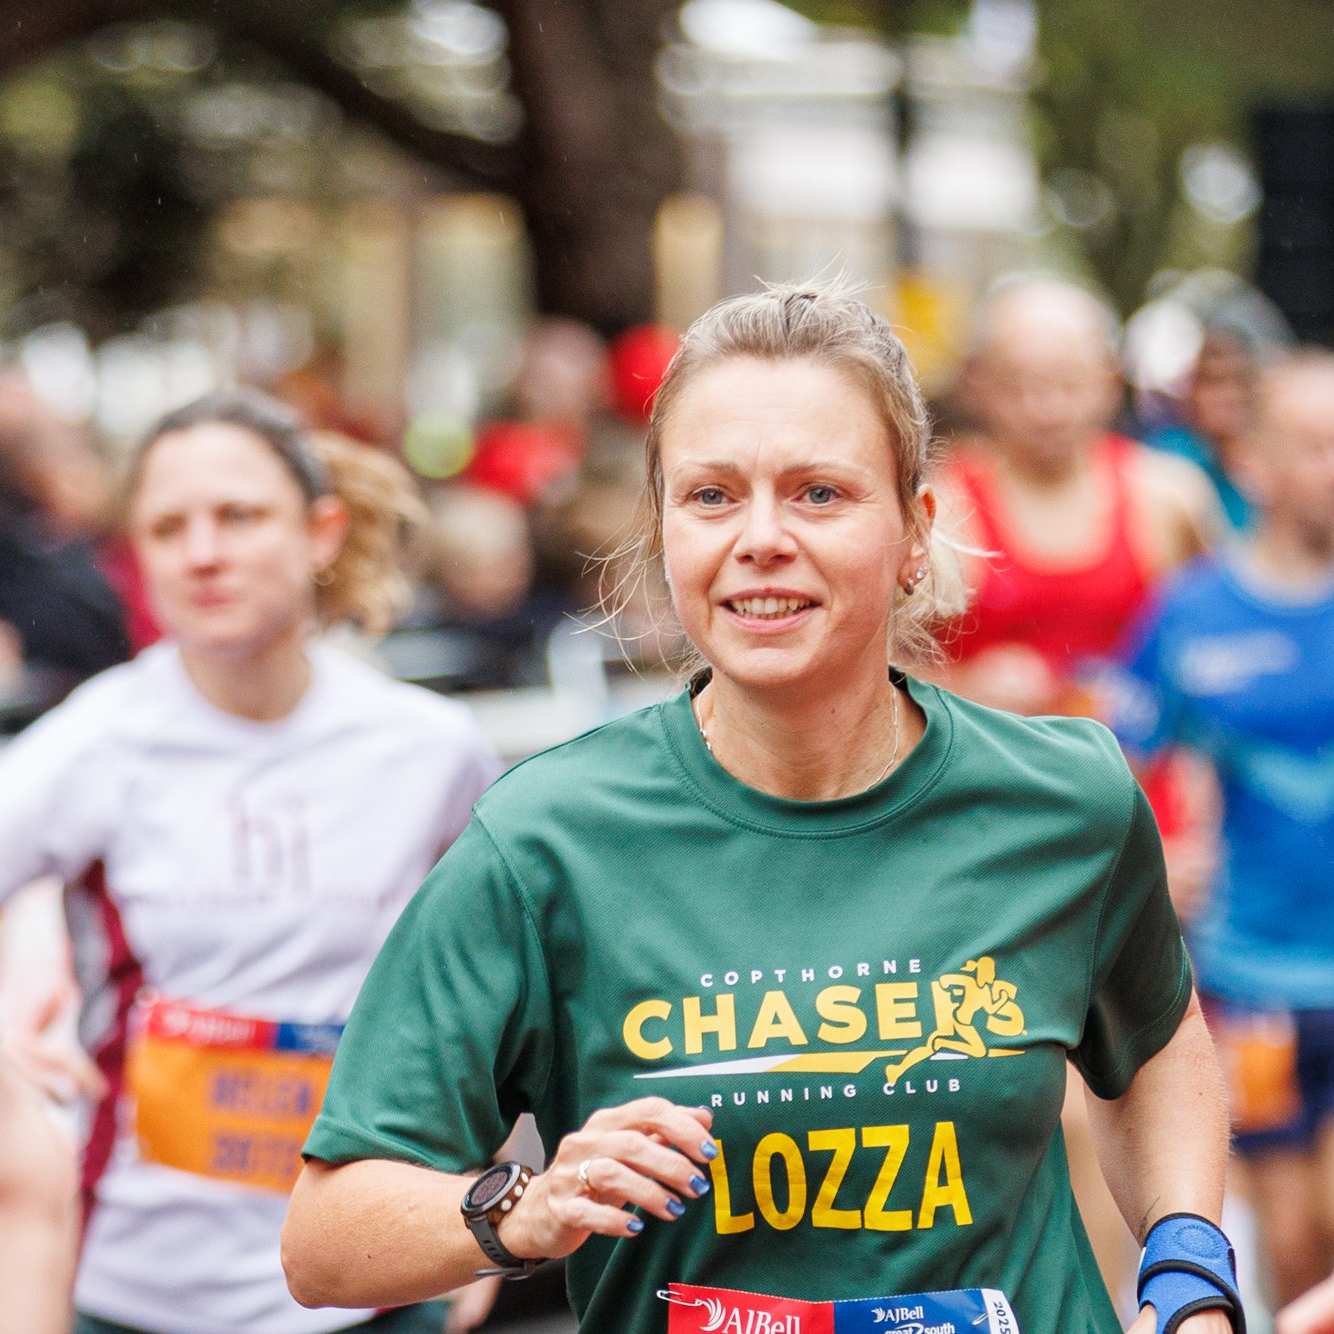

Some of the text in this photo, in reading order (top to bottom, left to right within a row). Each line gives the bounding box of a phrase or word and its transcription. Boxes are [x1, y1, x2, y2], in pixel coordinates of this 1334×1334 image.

[699, 957, 923, 988] COPTHORNE
[710, 1076, 962, 1109] RUNNING CLUB
[708, 1120, 974, 1235] LOZZA
